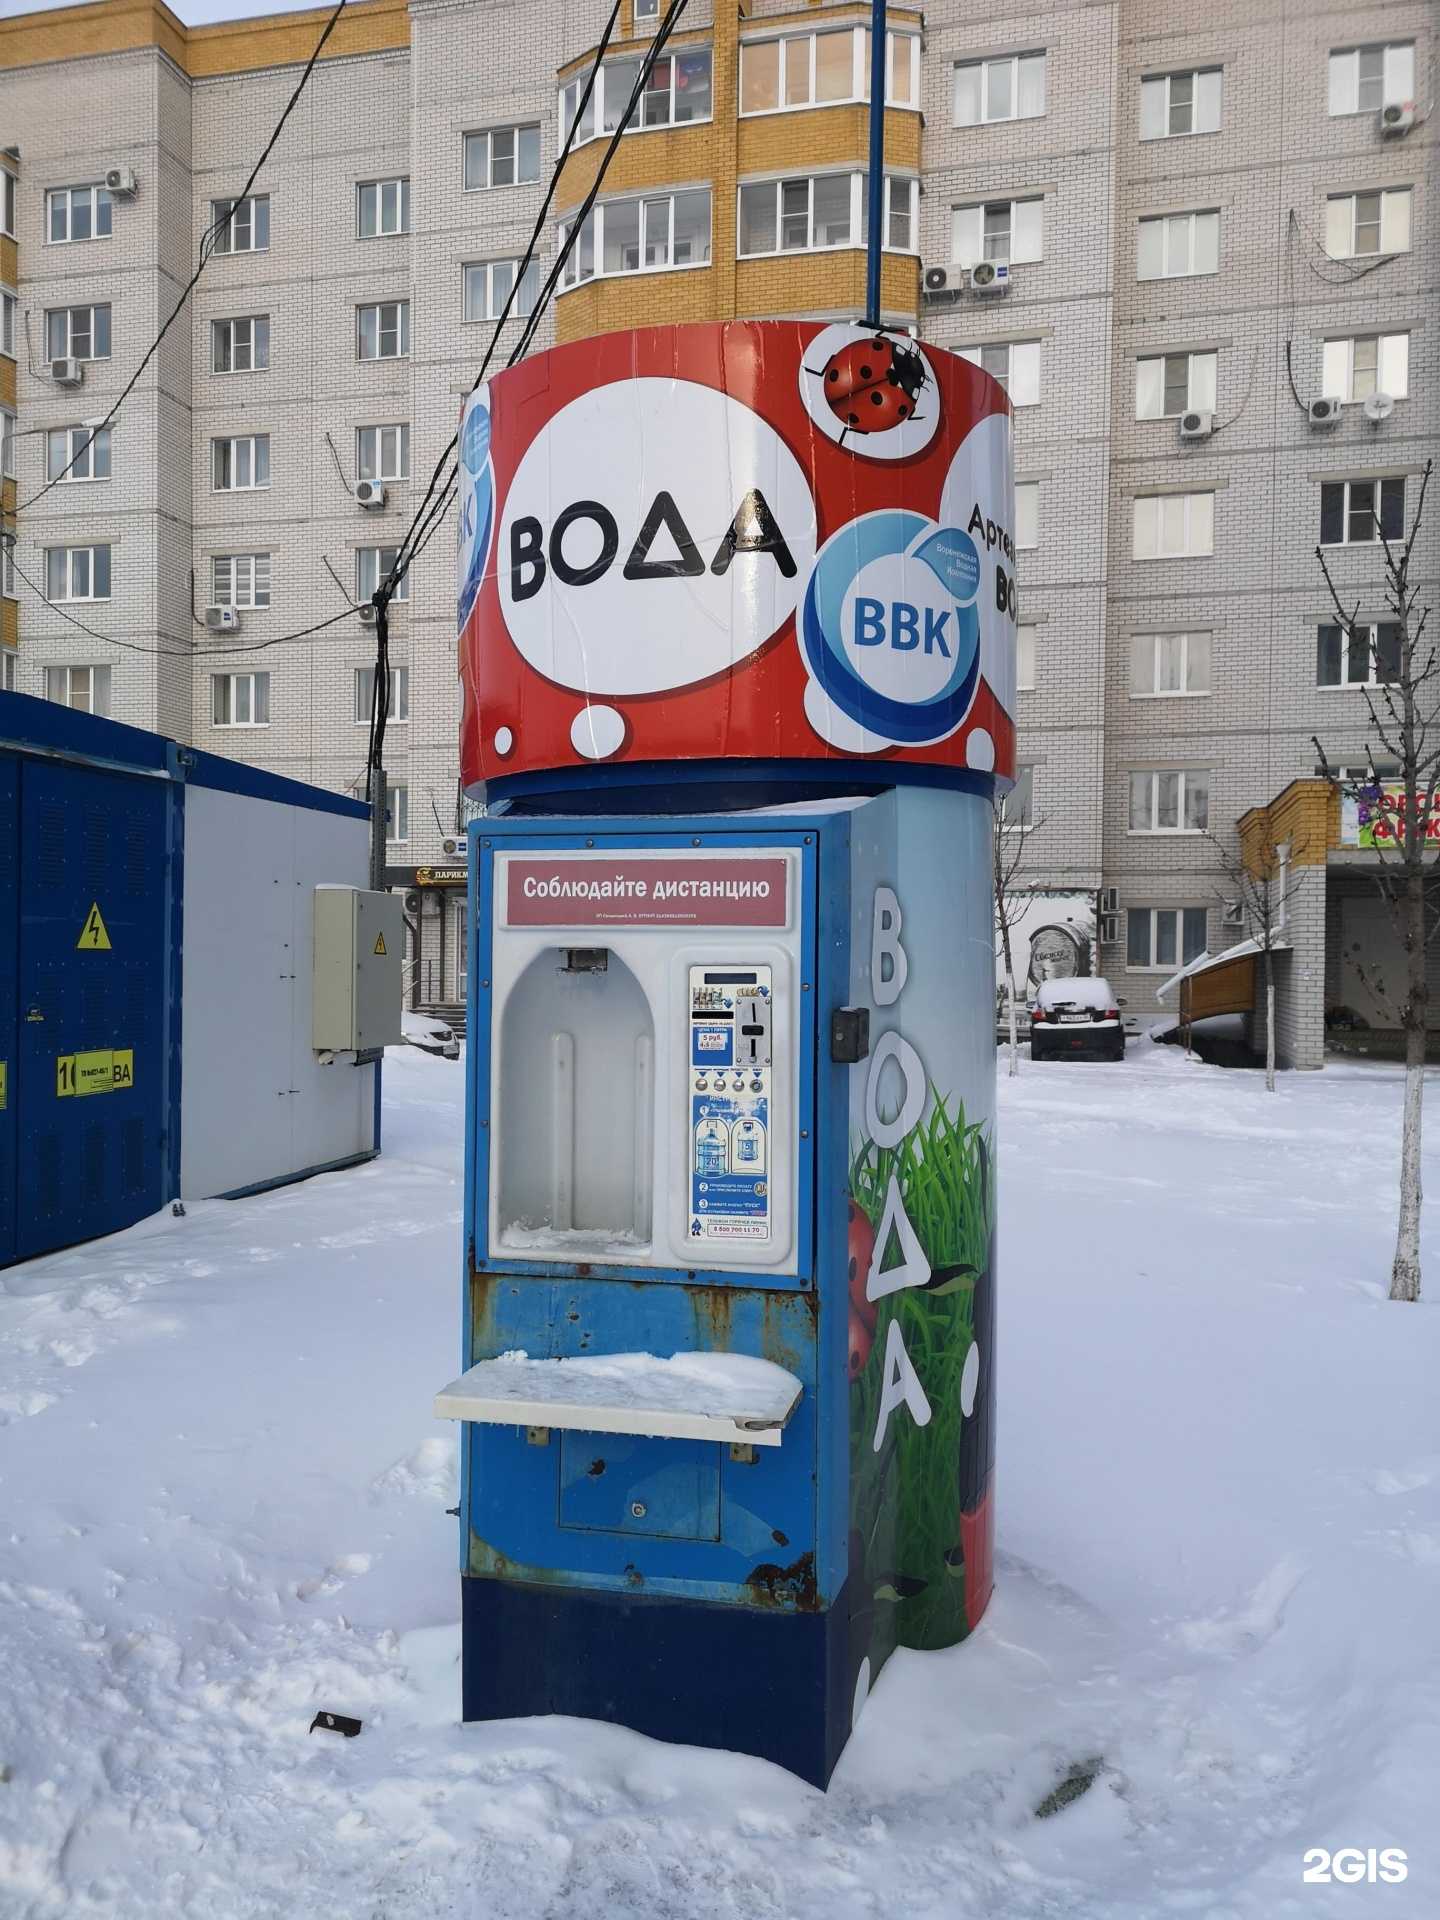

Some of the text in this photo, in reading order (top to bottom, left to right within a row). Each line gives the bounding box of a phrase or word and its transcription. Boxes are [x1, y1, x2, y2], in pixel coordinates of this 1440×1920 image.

[511, 488, 798, 603] ВОДА
[853, 598, 953, 658] ВВК
[523, 875, 770, 900] Соблюдайте дистанцию
